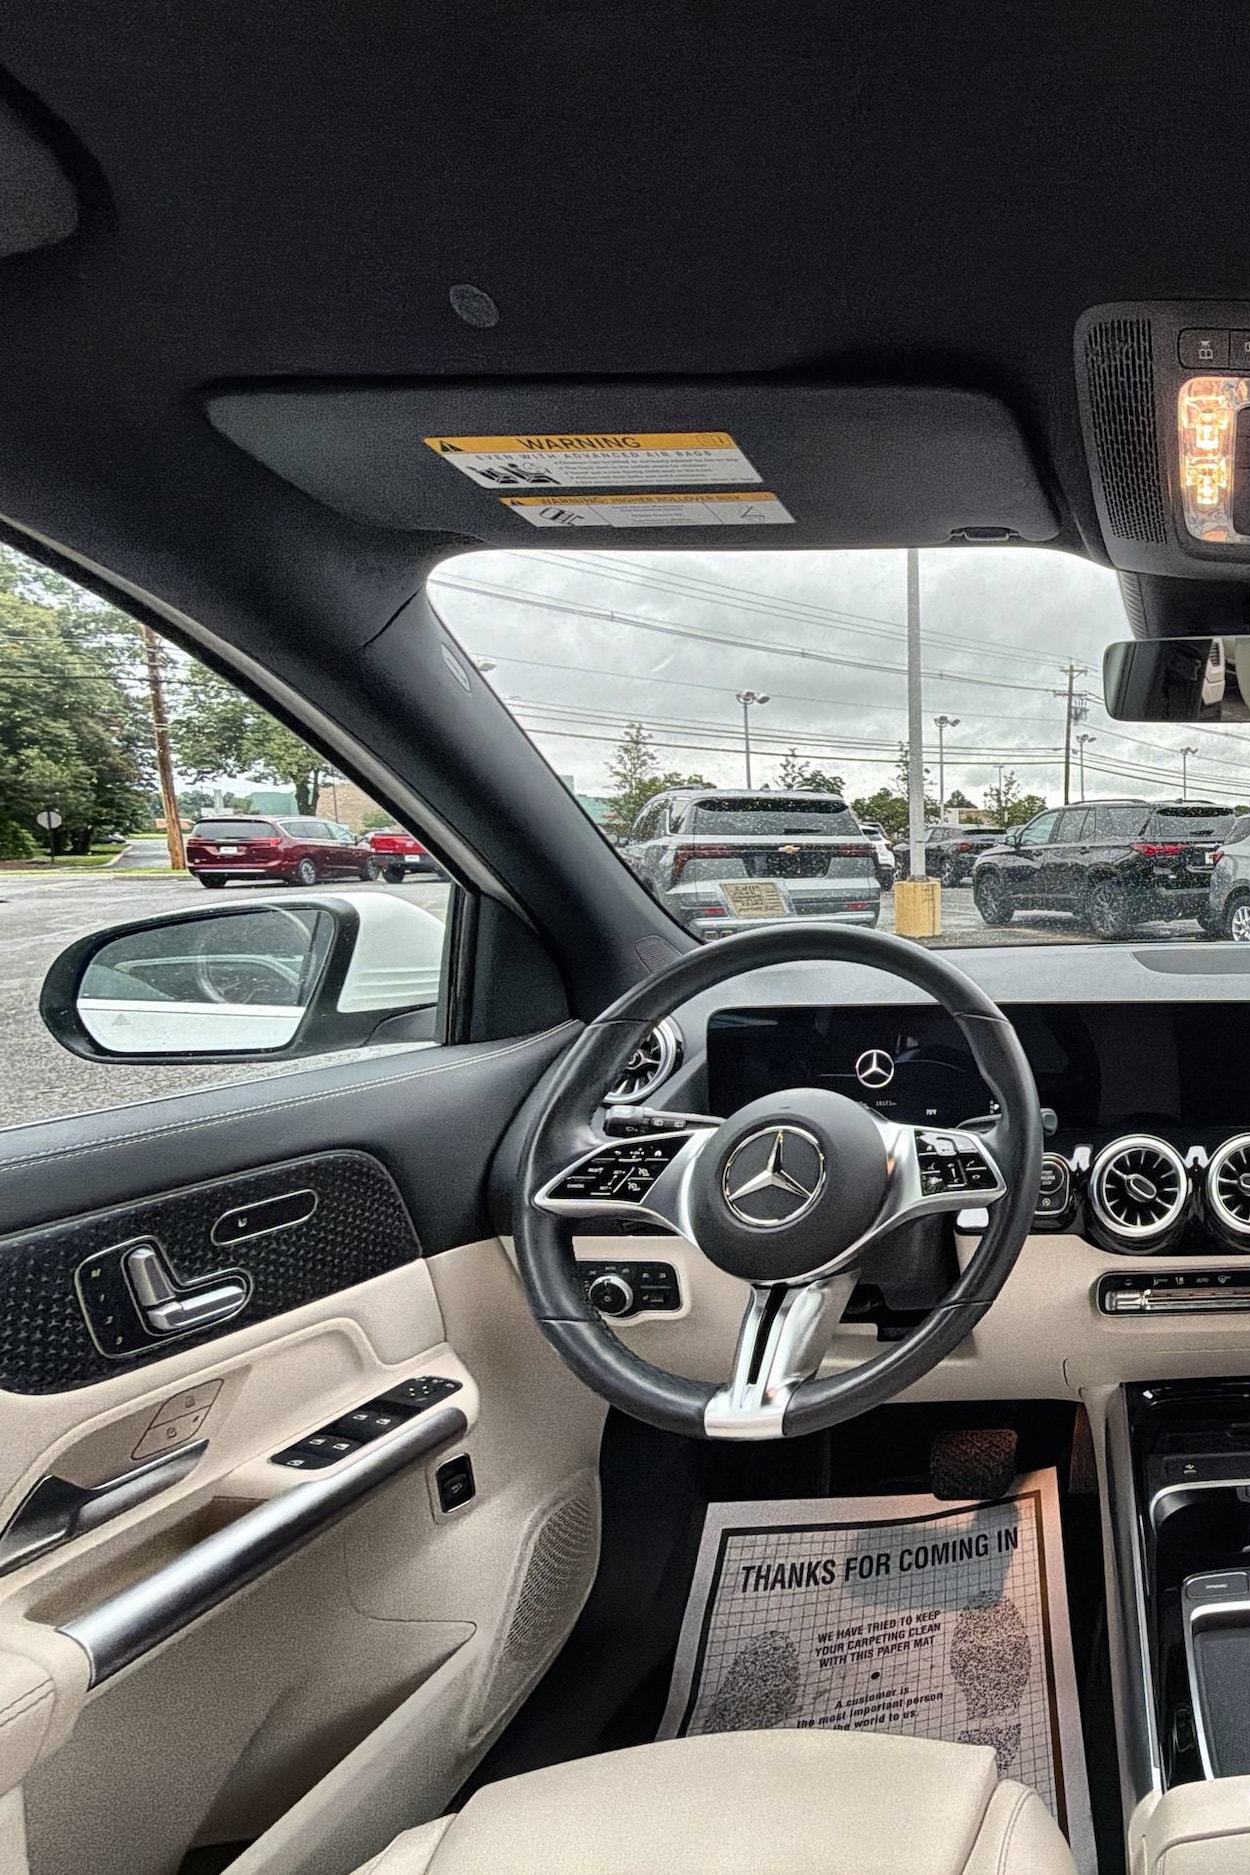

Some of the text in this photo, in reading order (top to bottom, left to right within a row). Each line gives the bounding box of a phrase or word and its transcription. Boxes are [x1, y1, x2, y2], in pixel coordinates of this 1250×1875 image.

[516, 437, 641, 450] WARNING
[741, 1527, 1018, 1592] THANKS FOR COMING IN
[815, 1622, 941, 1657] YOUR CARPETING CLEAN
[818, 1610, 941, 1644] WE HAVE TRIED TO KEEP
[819, 1636, 935, 1668] WITH THIS PAPER MAT
[796, 1692, 943, 1729] the most important person
[834, 1686, 910, 1710] A customer is
[854, 1711, 885, 1729] world
[889, 1710, 899, 1722] to
